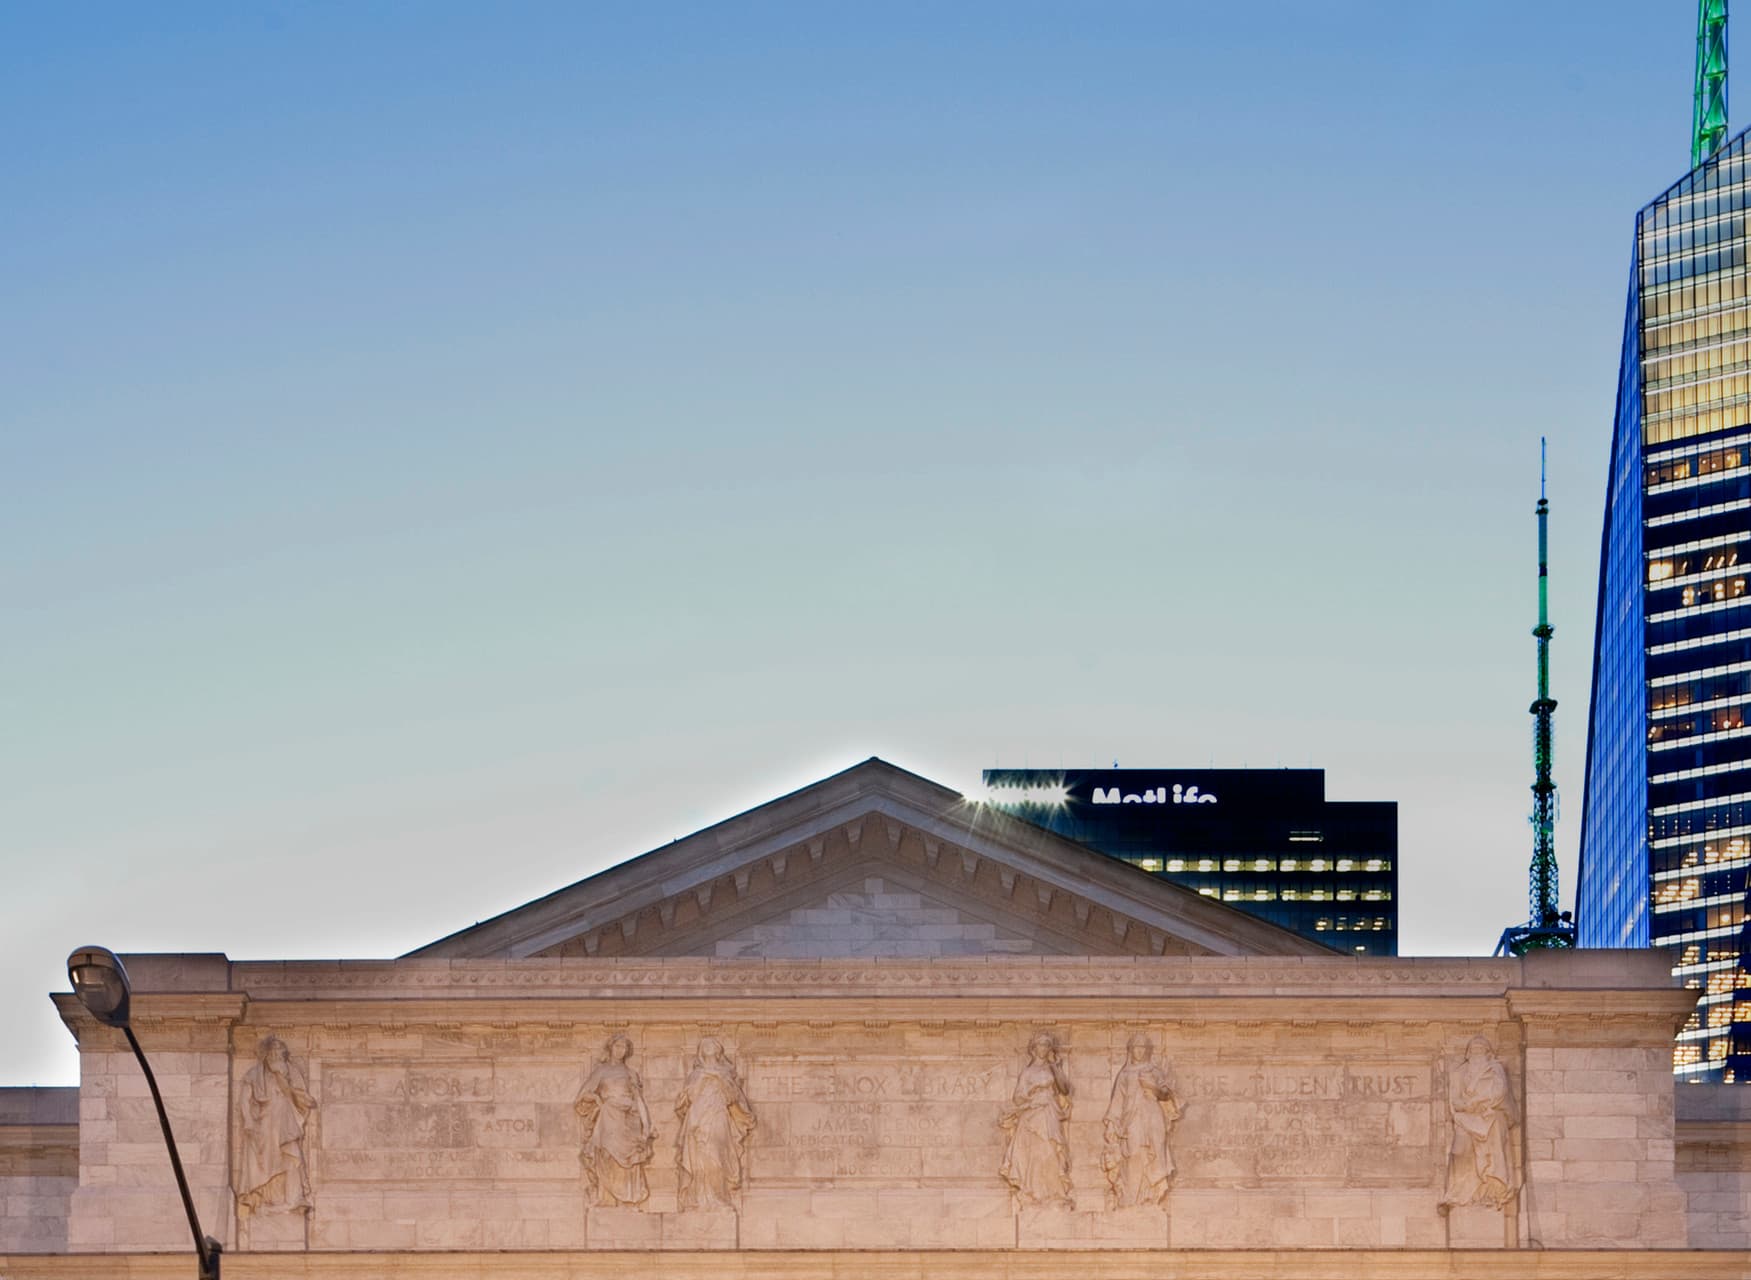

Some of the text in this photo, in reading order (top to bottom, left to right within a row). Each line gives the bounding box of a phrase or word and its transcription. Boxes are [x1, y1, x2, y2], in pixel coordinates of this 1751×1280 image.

[393, 1077, 462, 1096] ASTOR
[762, 1076, 804, 1095] THE
[900, 1076, 993, 1096] LIBRARY
[1249, 1075, 1328, 1095] TILDEN
[1350, 1075, 1419, 1096] TRUST
[482, 1119, 535, 1132] ASTOR
[812, 1118, 942, 1131] JAMES LENOX
